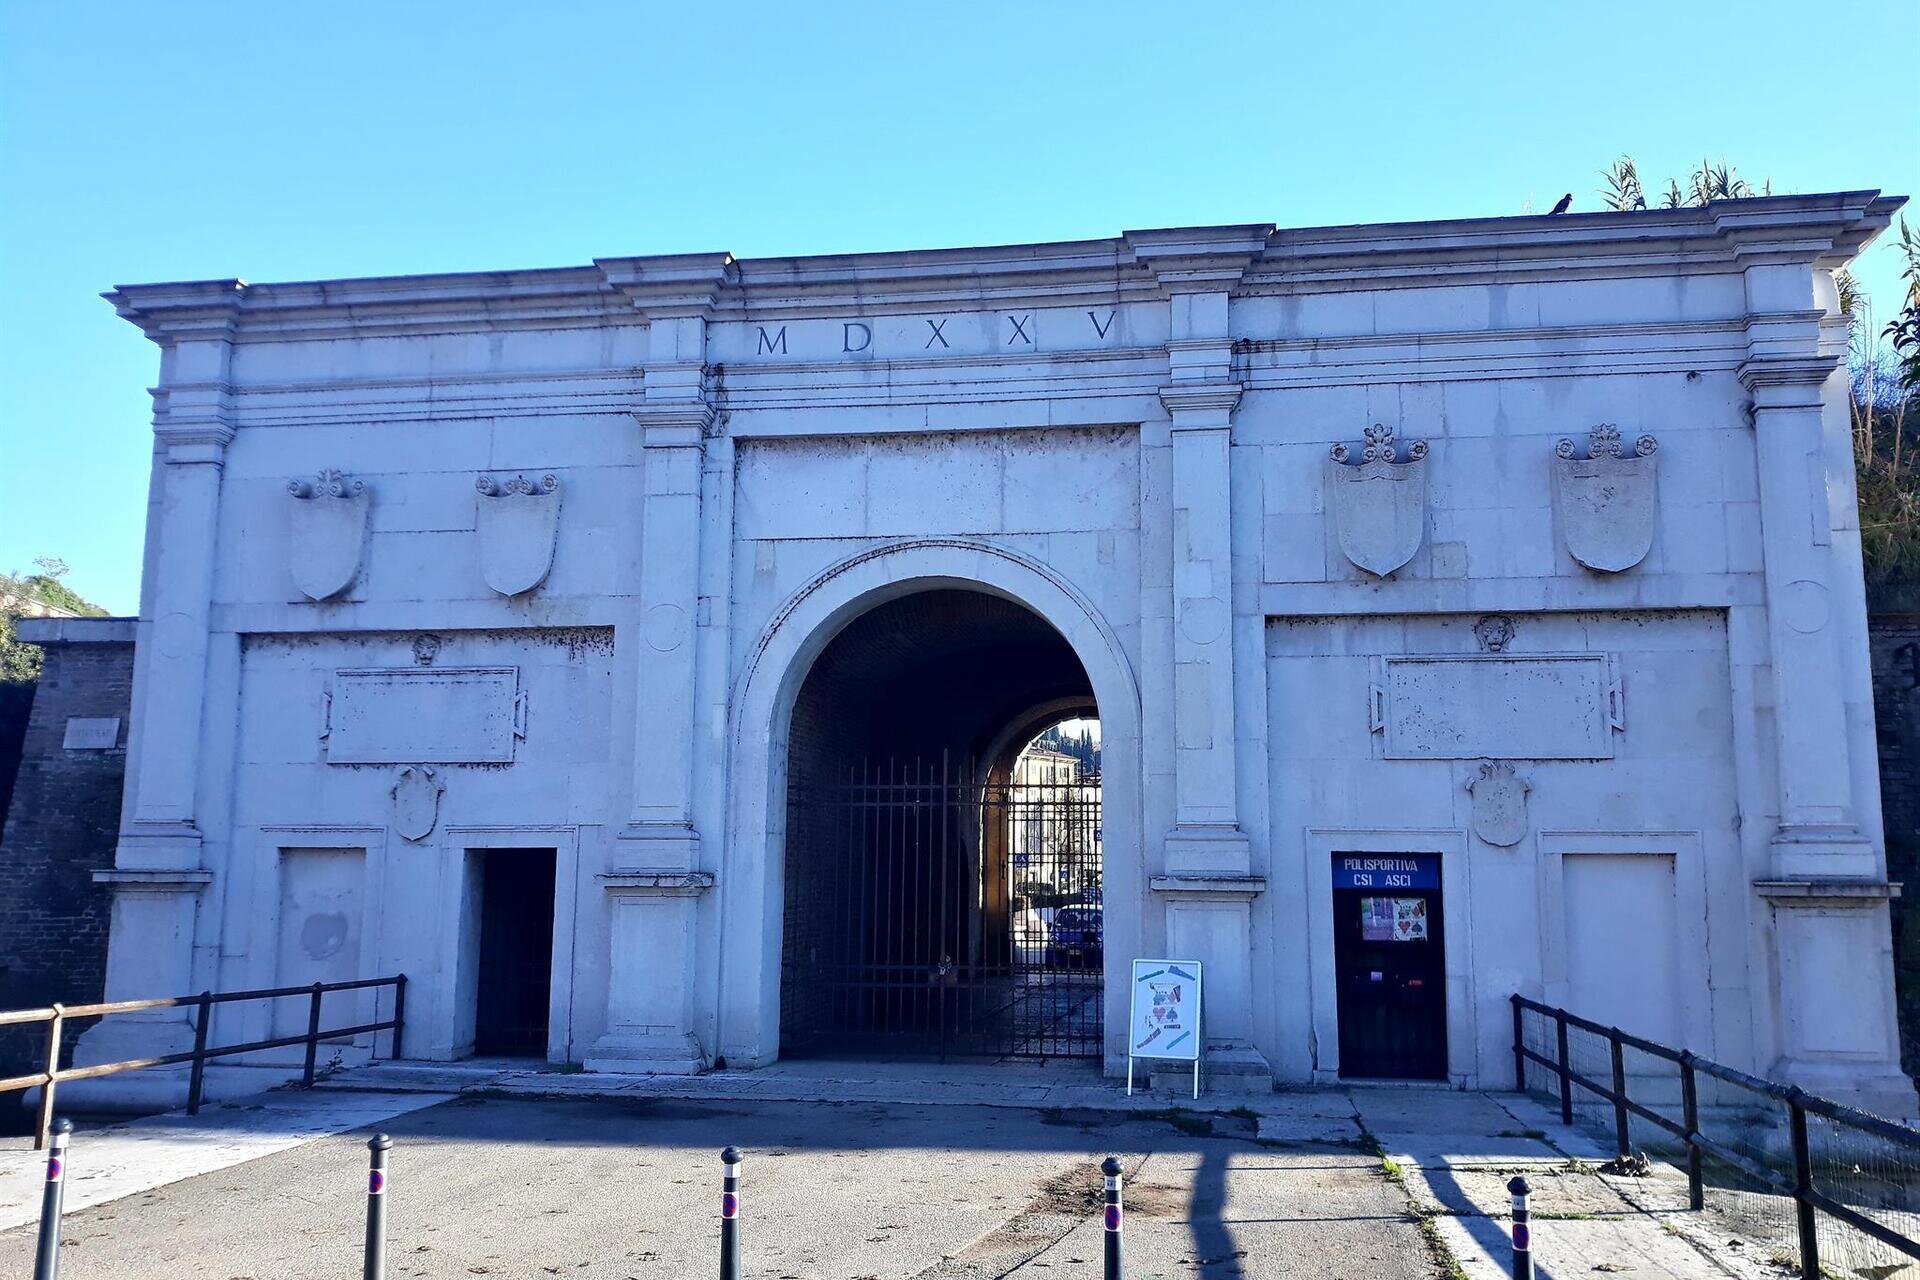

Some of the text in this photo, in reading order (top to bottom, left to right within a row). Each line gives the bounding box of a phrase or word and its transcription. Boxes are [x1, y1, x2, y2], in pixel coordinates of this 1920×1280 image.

[1344, 858, 1418, 872] POLISPORTIVA
[1353, 873, 1411, 887] CSI ASCI
